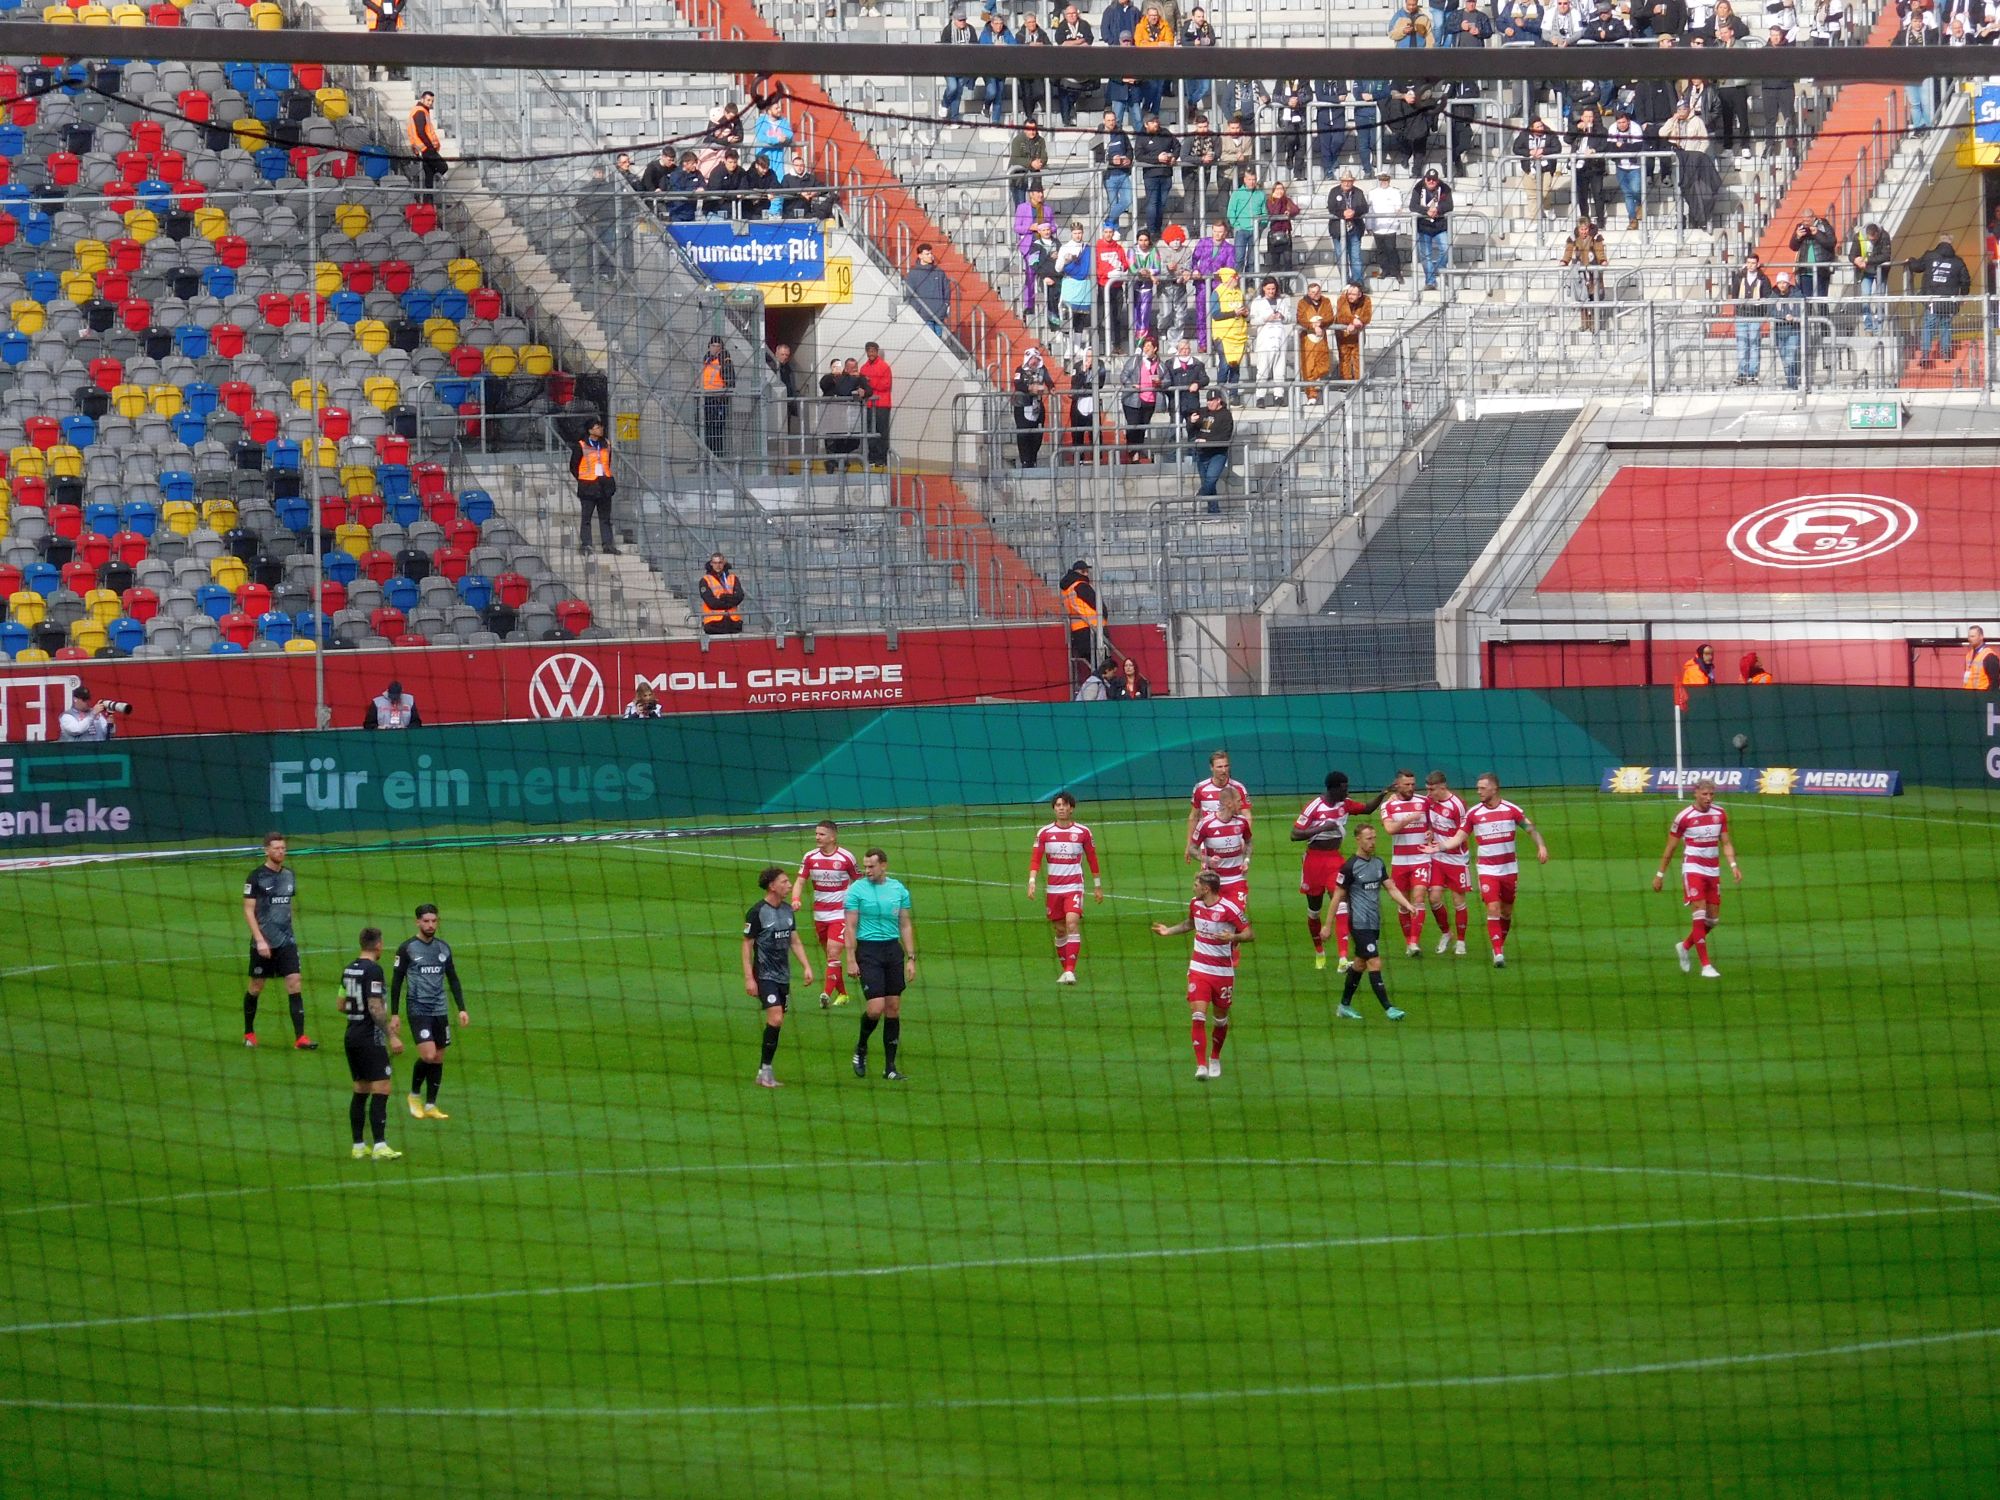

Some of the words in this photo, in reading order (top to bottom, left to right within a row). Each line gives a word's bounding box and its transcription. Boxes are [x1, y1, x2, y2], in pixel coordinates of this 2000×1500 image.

[681, 238, 784, 266] humacher
[788, 237, 818, 265] Alt
[837, 266, 850, 297] 19
[781, 282, 803, 303] 19
[634, 671, 738, 692] MOLL
[747, 664, 904, 688] GRUPPE
[748, 693, 787, 705] AUTO
[791, 687, 904, 702] PERFORMANCE
[269, 757, 368, 813] Für
[383, 753, 471, 809] ein
[486, 762, 656, 808] neues
[1804, 770, 1890, 789] MERKUR
[1459, 872, 1467, 884] 8
[1073, 893, 1080, 904] 4
[1220, 986, 1233, 999] 25
